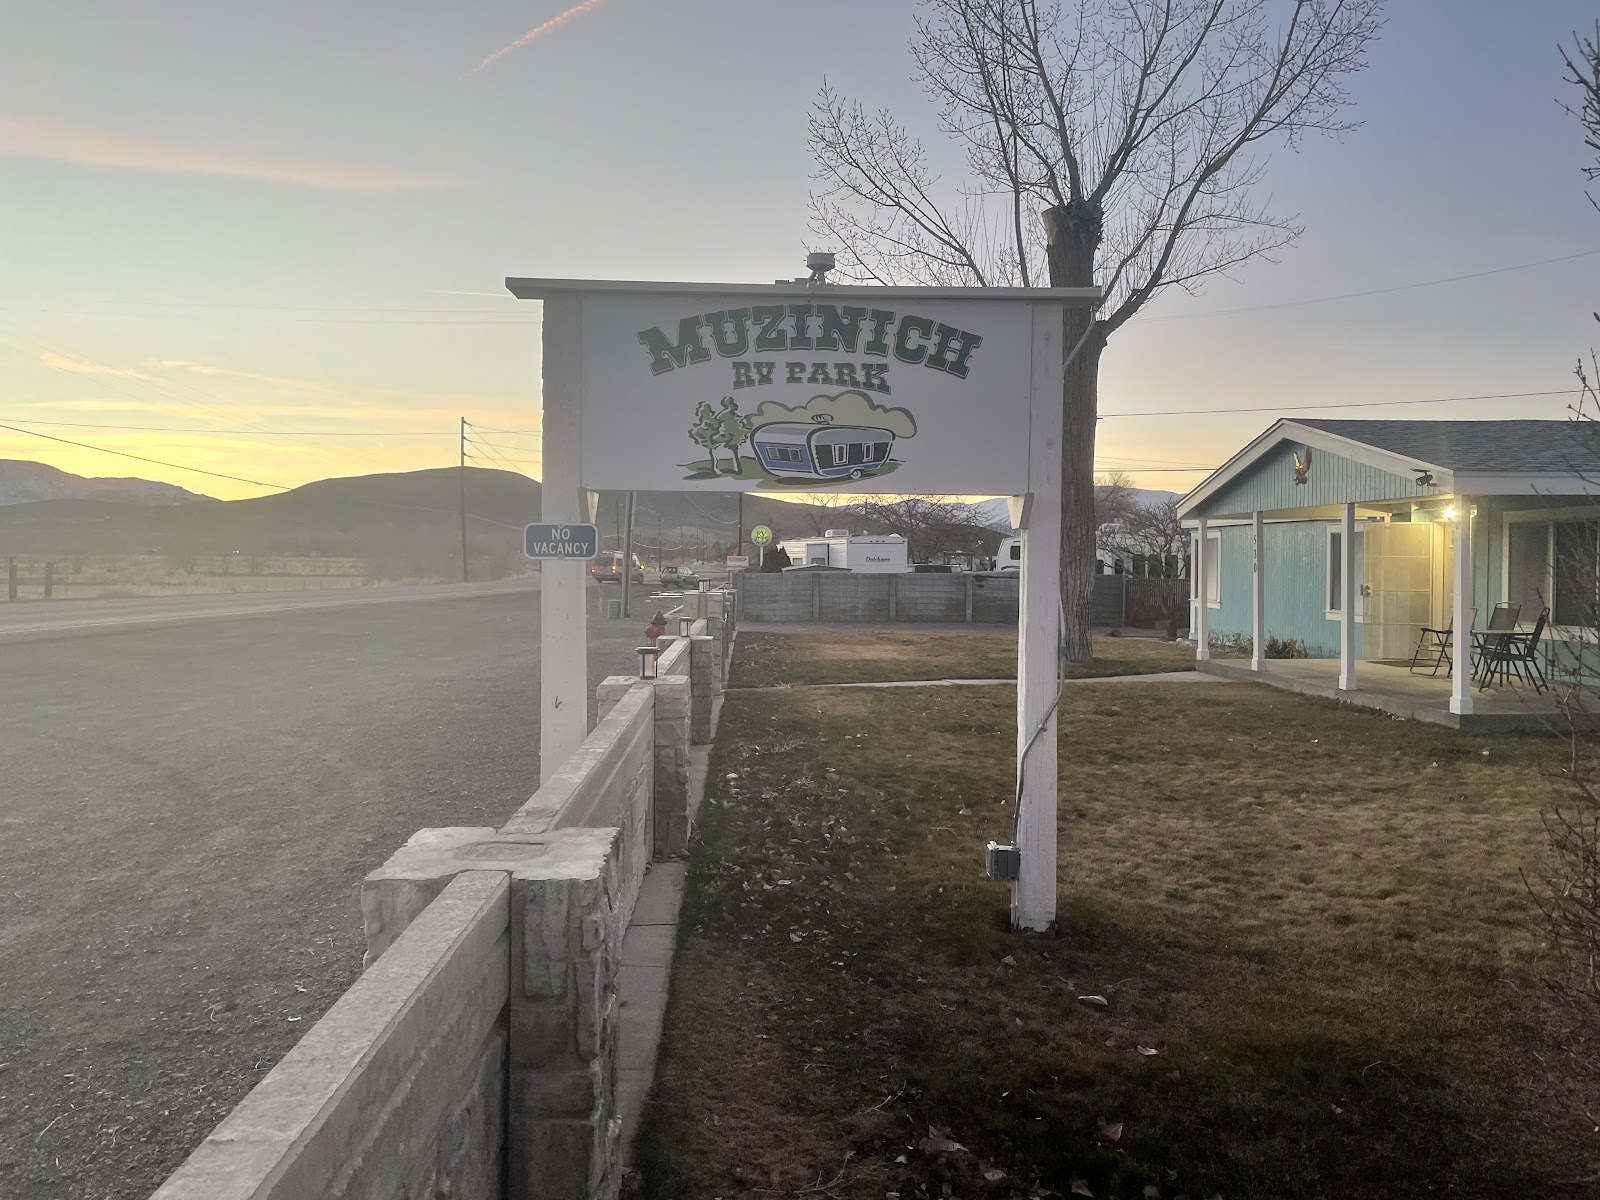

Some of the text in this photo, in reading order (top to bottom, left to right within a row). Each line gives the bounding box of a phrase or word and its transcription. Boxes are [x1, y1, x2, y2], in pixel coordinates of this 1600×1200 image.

[637, 303, 983, 379] MUZINICH
[732, 361, 892, 395] RV PARK
[551, 528, 571, 541] NO
[533, 542, 589, 555] VACANCY
